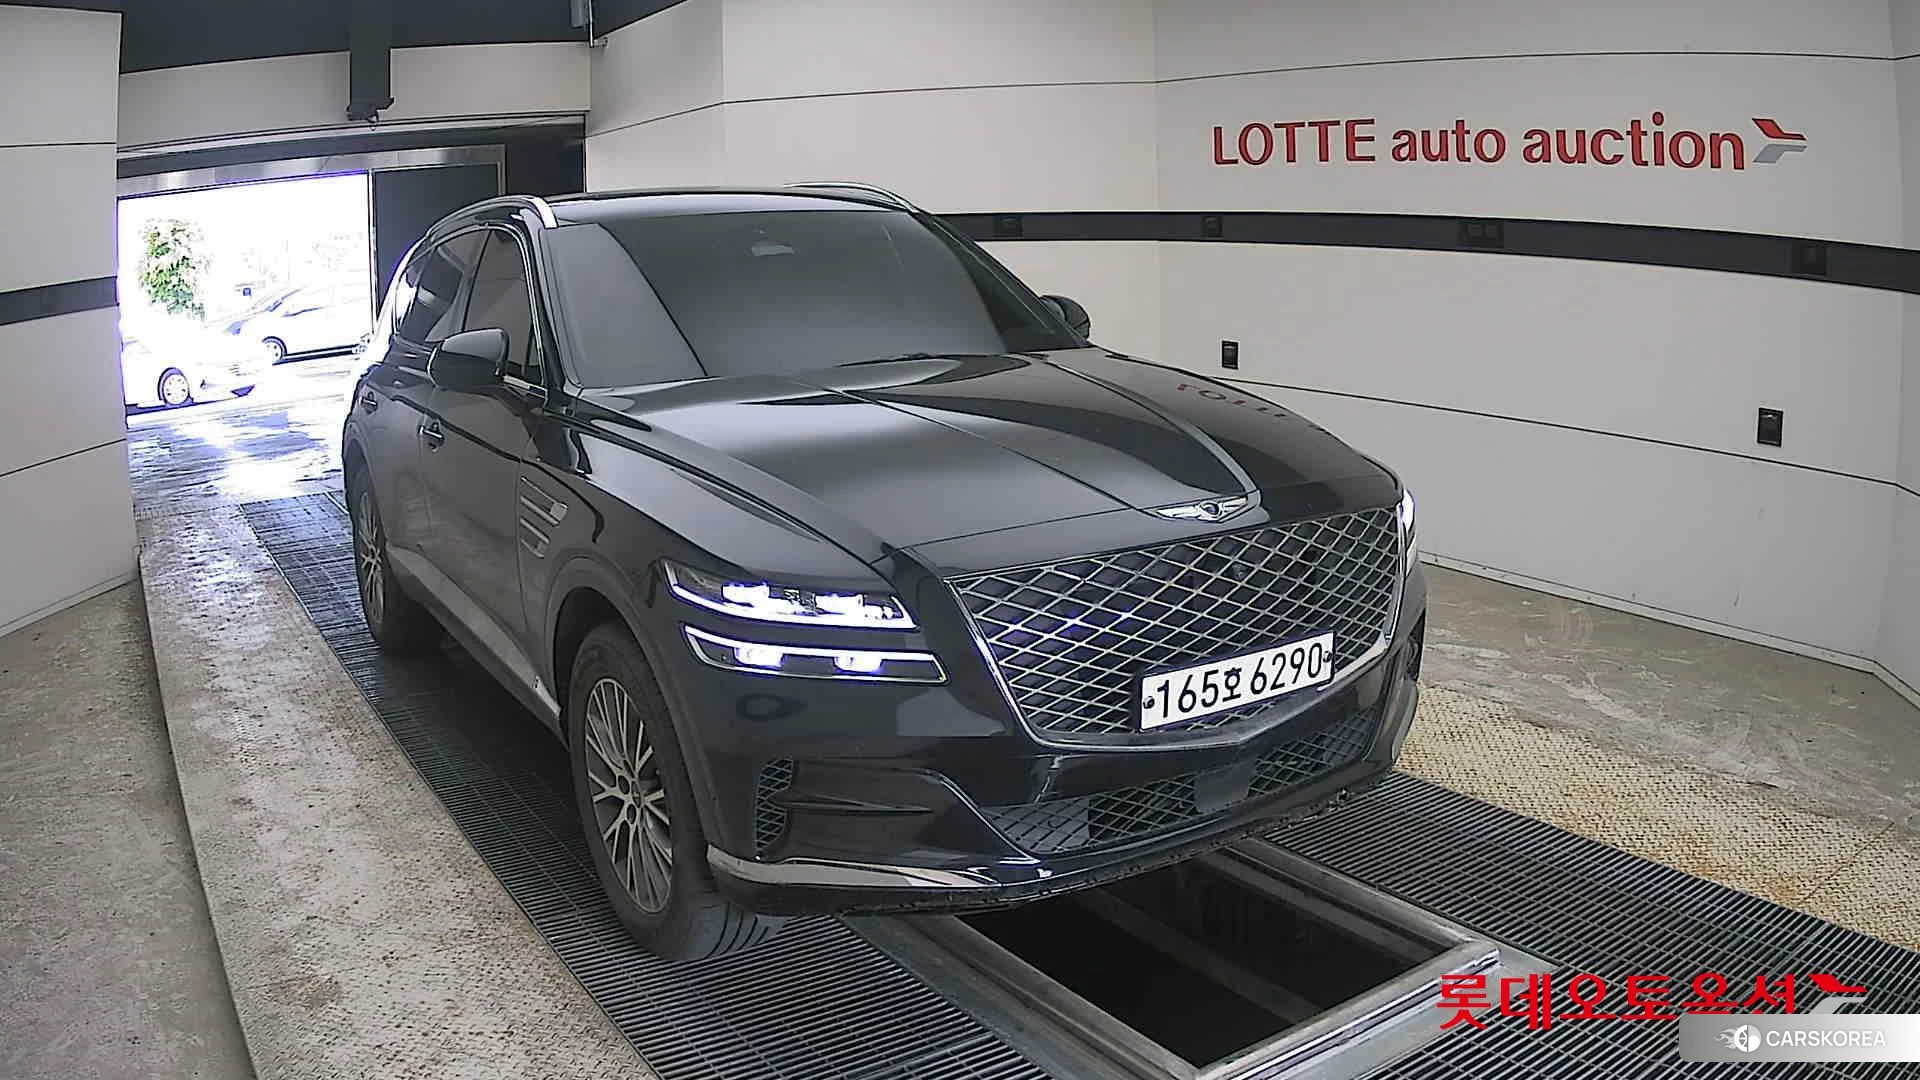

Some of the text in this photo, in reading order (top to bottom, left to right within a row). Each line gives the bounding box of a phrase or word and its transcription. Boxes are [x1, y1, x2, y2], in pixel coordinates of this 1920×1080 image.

[1213, 112, 1745, 170] LOTTE auto auction
